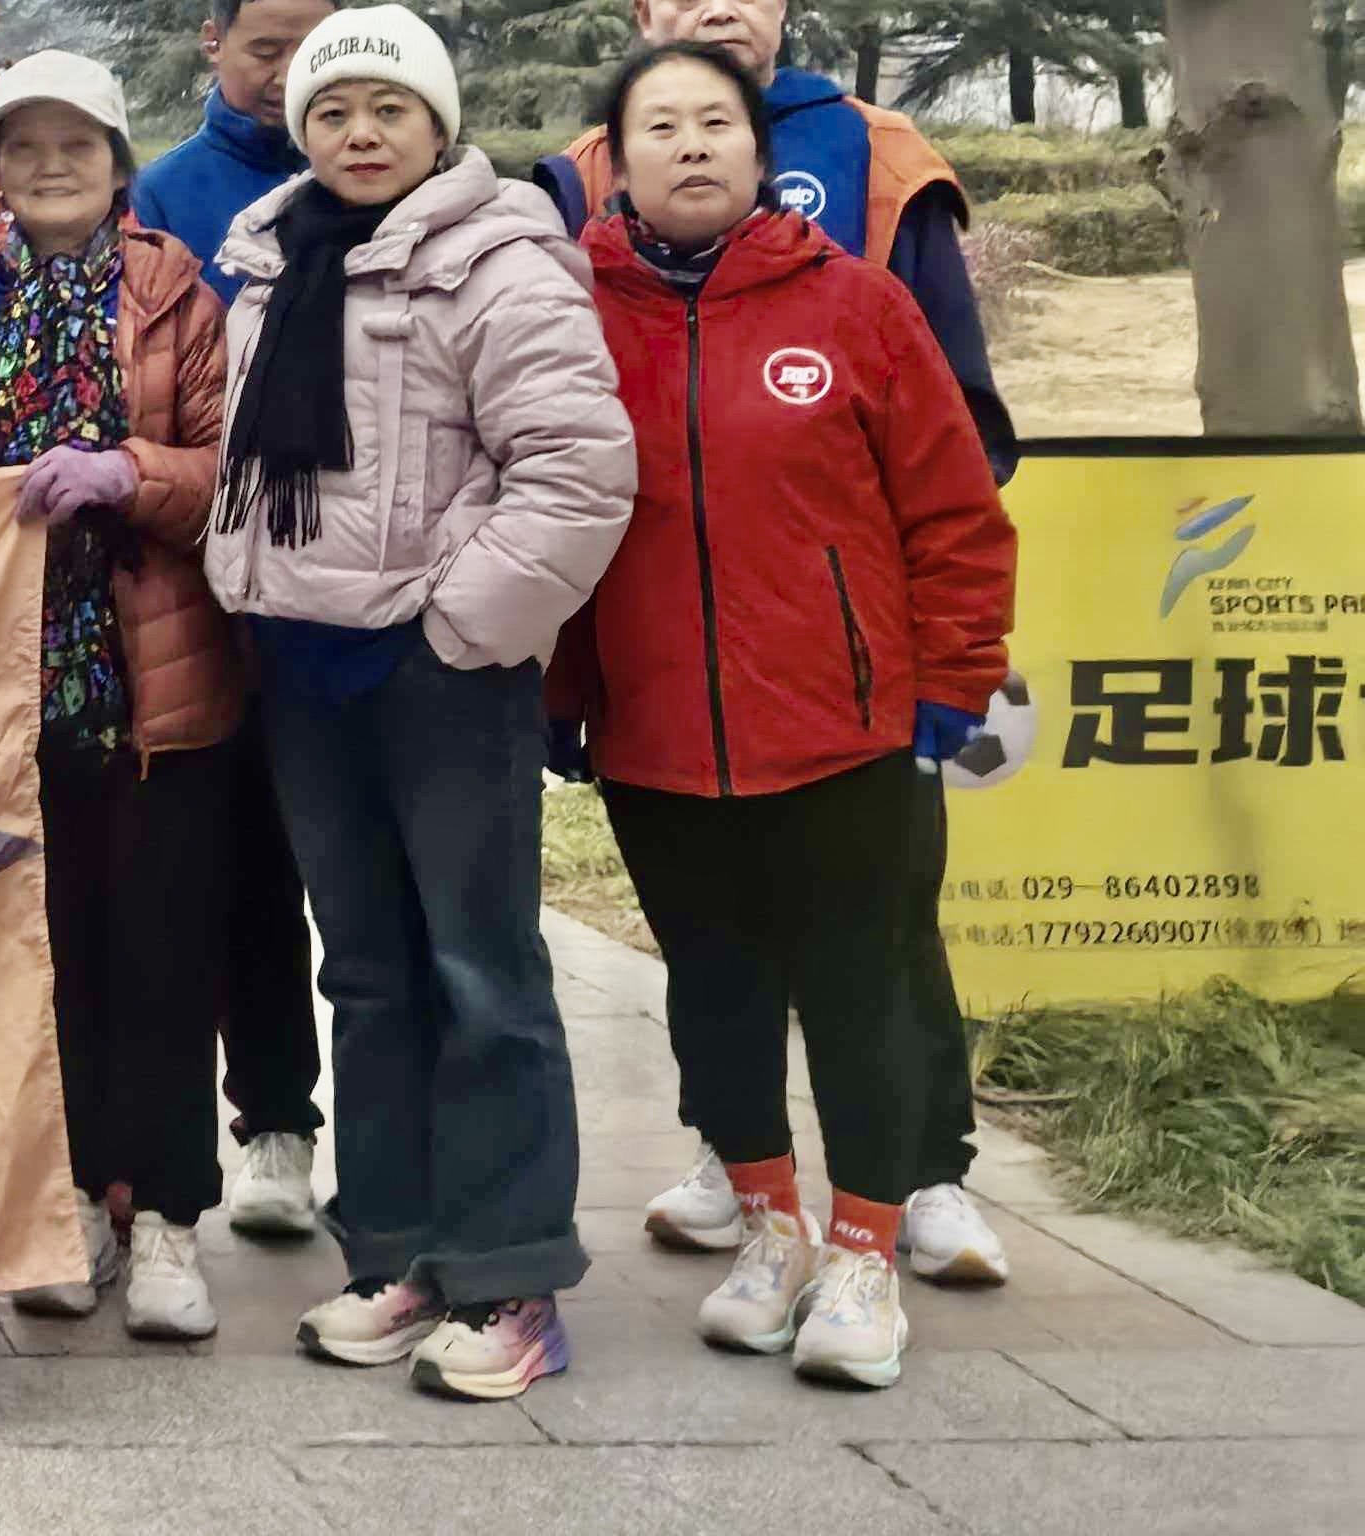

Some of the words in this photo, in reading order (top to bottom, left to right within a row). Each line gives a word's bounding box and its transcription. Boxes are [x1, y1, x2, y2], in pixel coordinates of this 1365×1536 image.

[310, 36, 401, 74] COLORADO
[1209, 594, 1314, 615] SPORTS
[1324, 594, 1365, 615] PA
[1062, 654, 1365, 768] 足球
